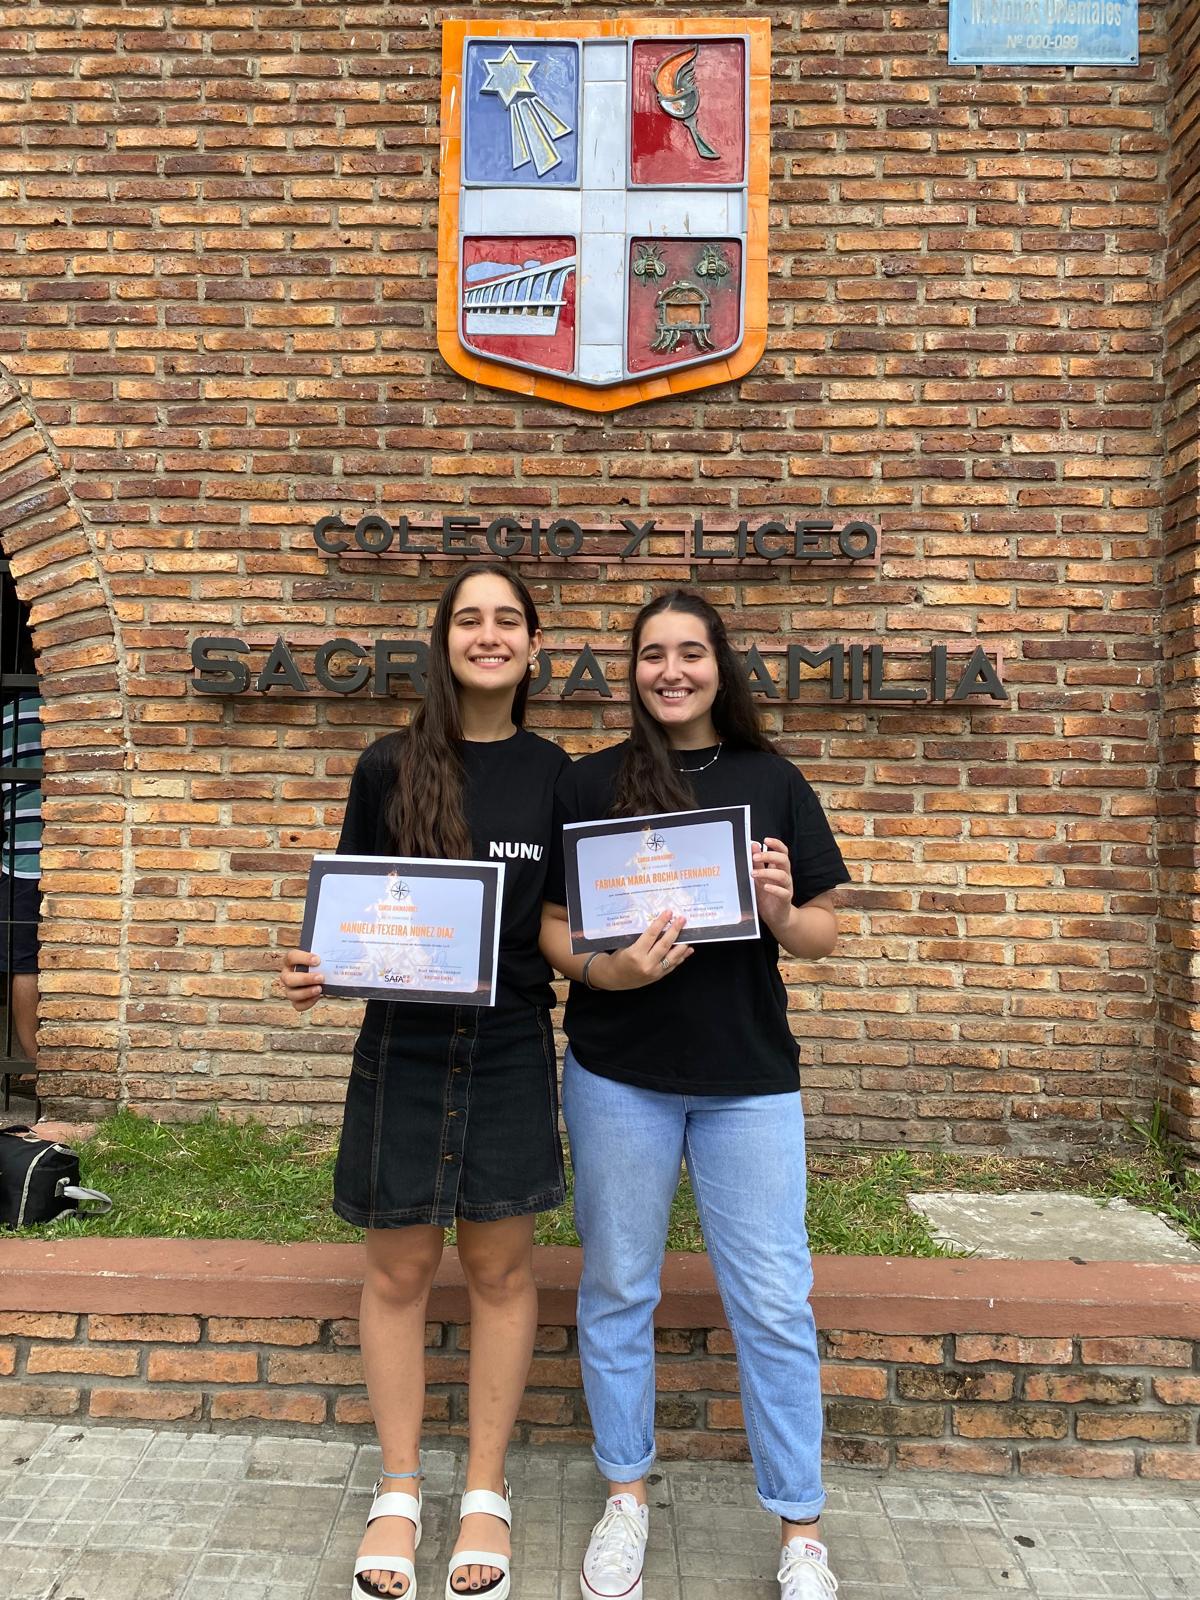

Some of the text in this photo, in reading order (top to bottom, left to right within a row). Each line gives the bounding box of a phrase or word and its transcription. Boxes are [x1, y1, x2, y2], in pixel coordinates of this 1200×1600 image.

[313, 515, 878, 560] COLEGIO Y LICEO
[191, 635, 1008, 701] SAGRA AMILIA
[489, 841, 543, 861] NUNU
[595, 876, 626, 891] FABIANA
[340, 922, 375, 935] MANUELA
[378, 924, 408, 936] TEXEIRA
